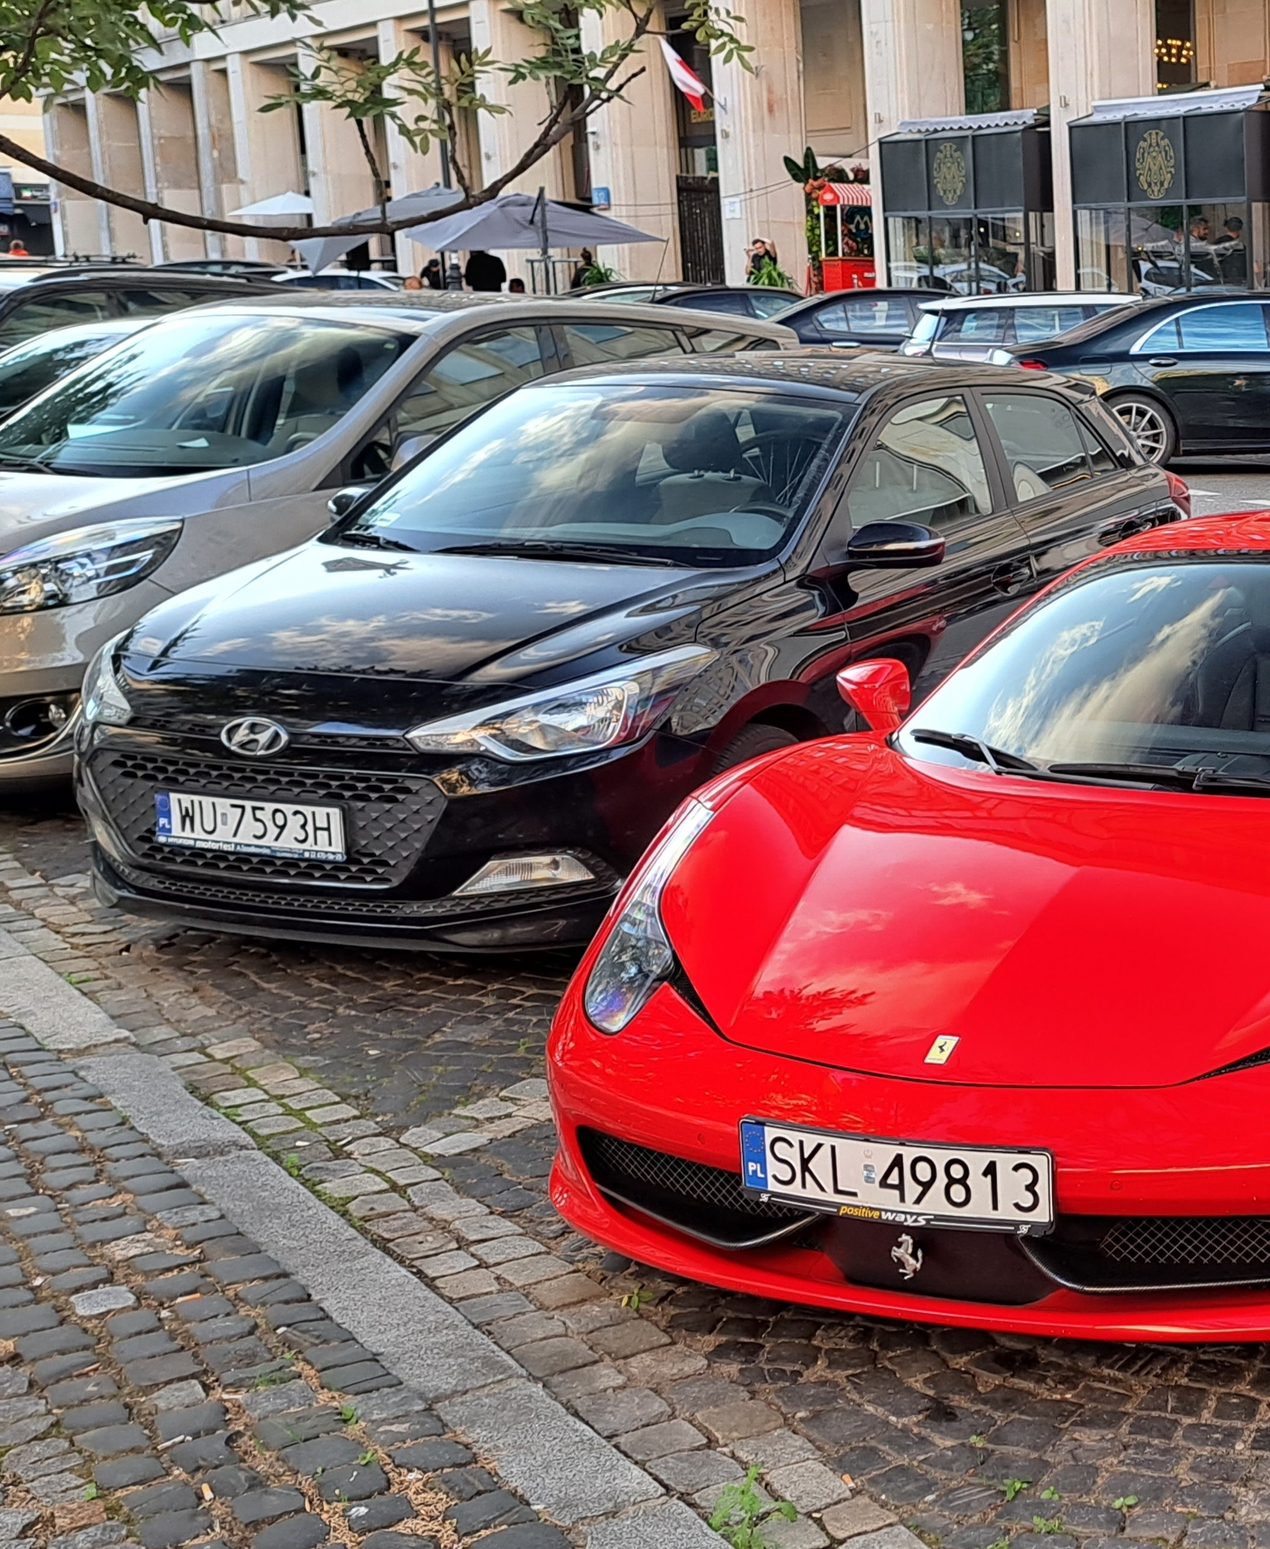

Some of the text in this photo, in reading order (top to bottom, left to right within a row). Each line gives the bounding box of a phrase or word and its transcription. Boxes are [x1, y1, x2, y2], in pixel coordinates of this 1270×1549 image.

[159, 817, 171, 829] PL
[177, 797, 333, 847] WU 7593H
[747, 1161, 765, 1178] PL
[769, 1136, 1040, 1213] SKL 49813
